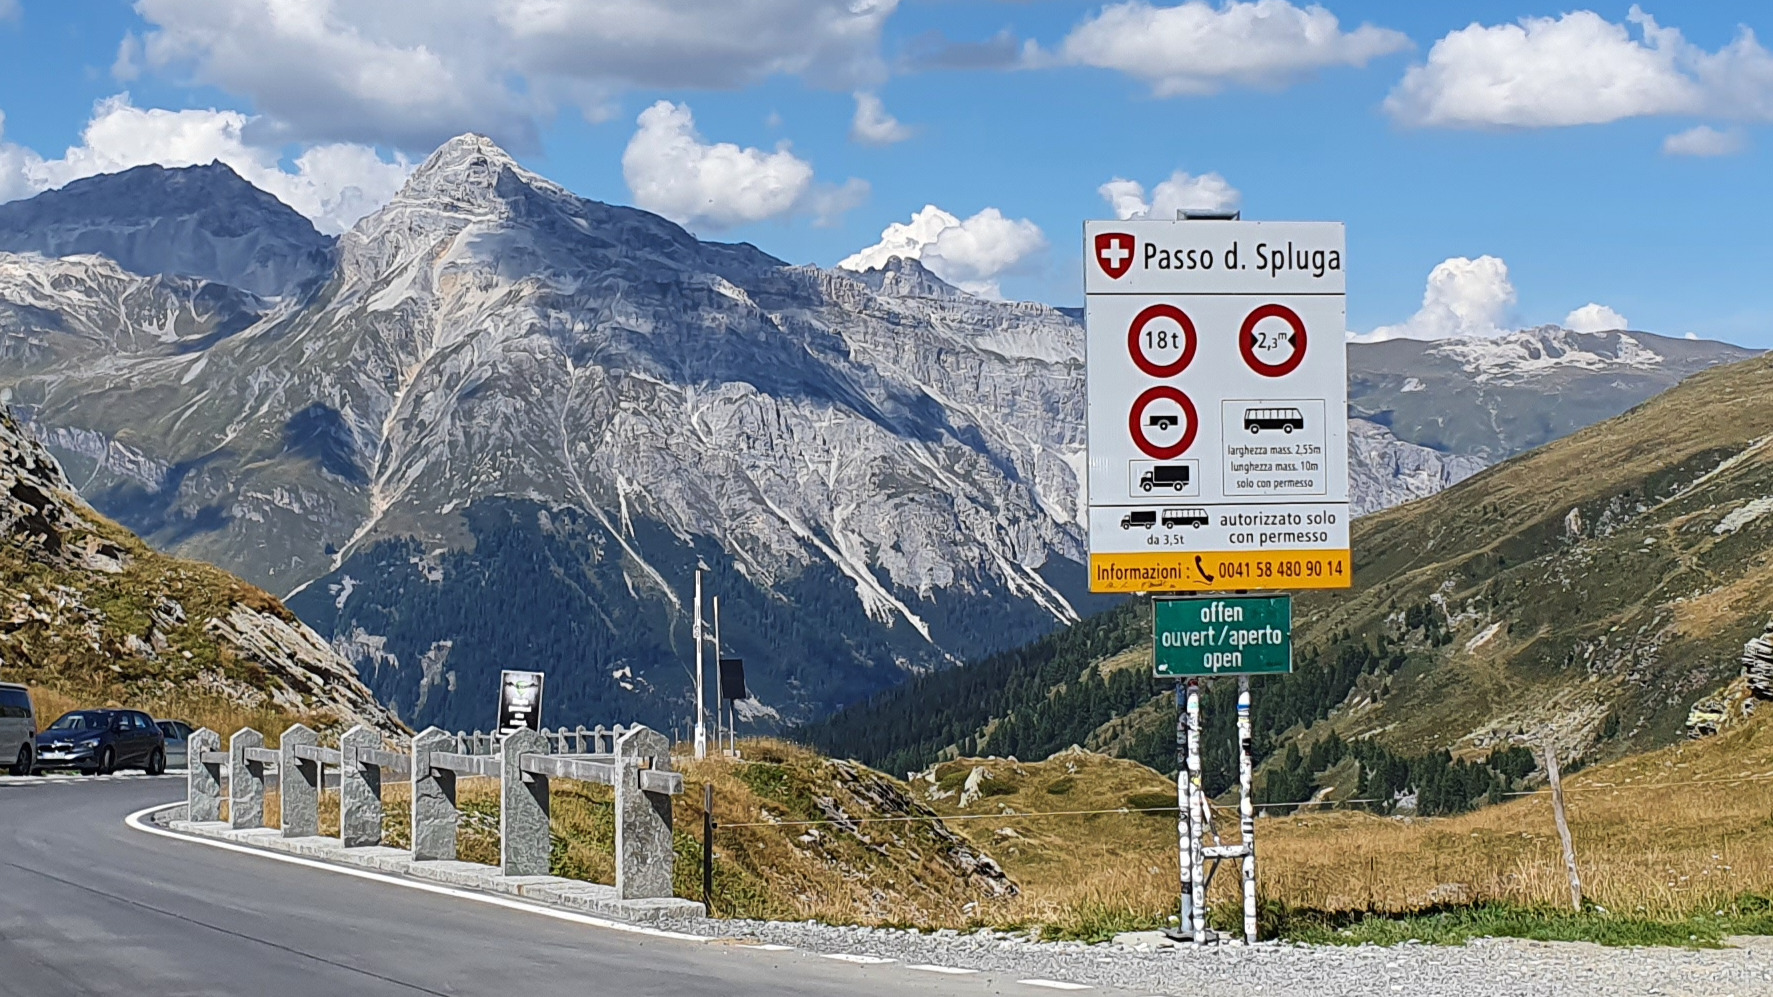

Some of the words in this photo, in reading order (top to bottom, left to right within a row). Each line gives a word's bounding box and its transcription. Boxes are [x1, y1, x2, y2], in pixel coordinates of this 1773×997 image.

[1144, 242, 1214, 270] Passo
[1224, 241, 1246, 270] d.
[1256, 241, 1341, 278] Spluga
[1227, 444, 1268, 458] larghezza
[1270, 446, 1293, 455] mass.
[1295, 444, 1321, 456] 2,55m
[1231, 461, 1273, 475] lunghezza
[1275, 463, 1298, 472] mass.
[1301, 461, 1319, 471] 10m
[1236, 478, 1254, 488] solo
[1256, 480, 1271, 488] con
[1273, 479, 1314, 490] permesso
[1220, 511, 1301, 526] autorizzato
[1306, 510, 1336, 525] solo
[1147, 534, 1160, 545] da
[1163, 534, 1185, 546] 3,5t
[1229, 532, 1254, 544] con
[1260, 531, 1328, 547] permesso
[1218, 562, 1250, 579] 0041
[1256, 561, 1272, 578] 58
[1277, 561, 1302, 577] 480
[1306, 560, 1322, 577] 90
[1327, 560, 1343, 577] 14
[1200, 601, 1243, 623] offen
[1203, 652, 1242, 673] open
